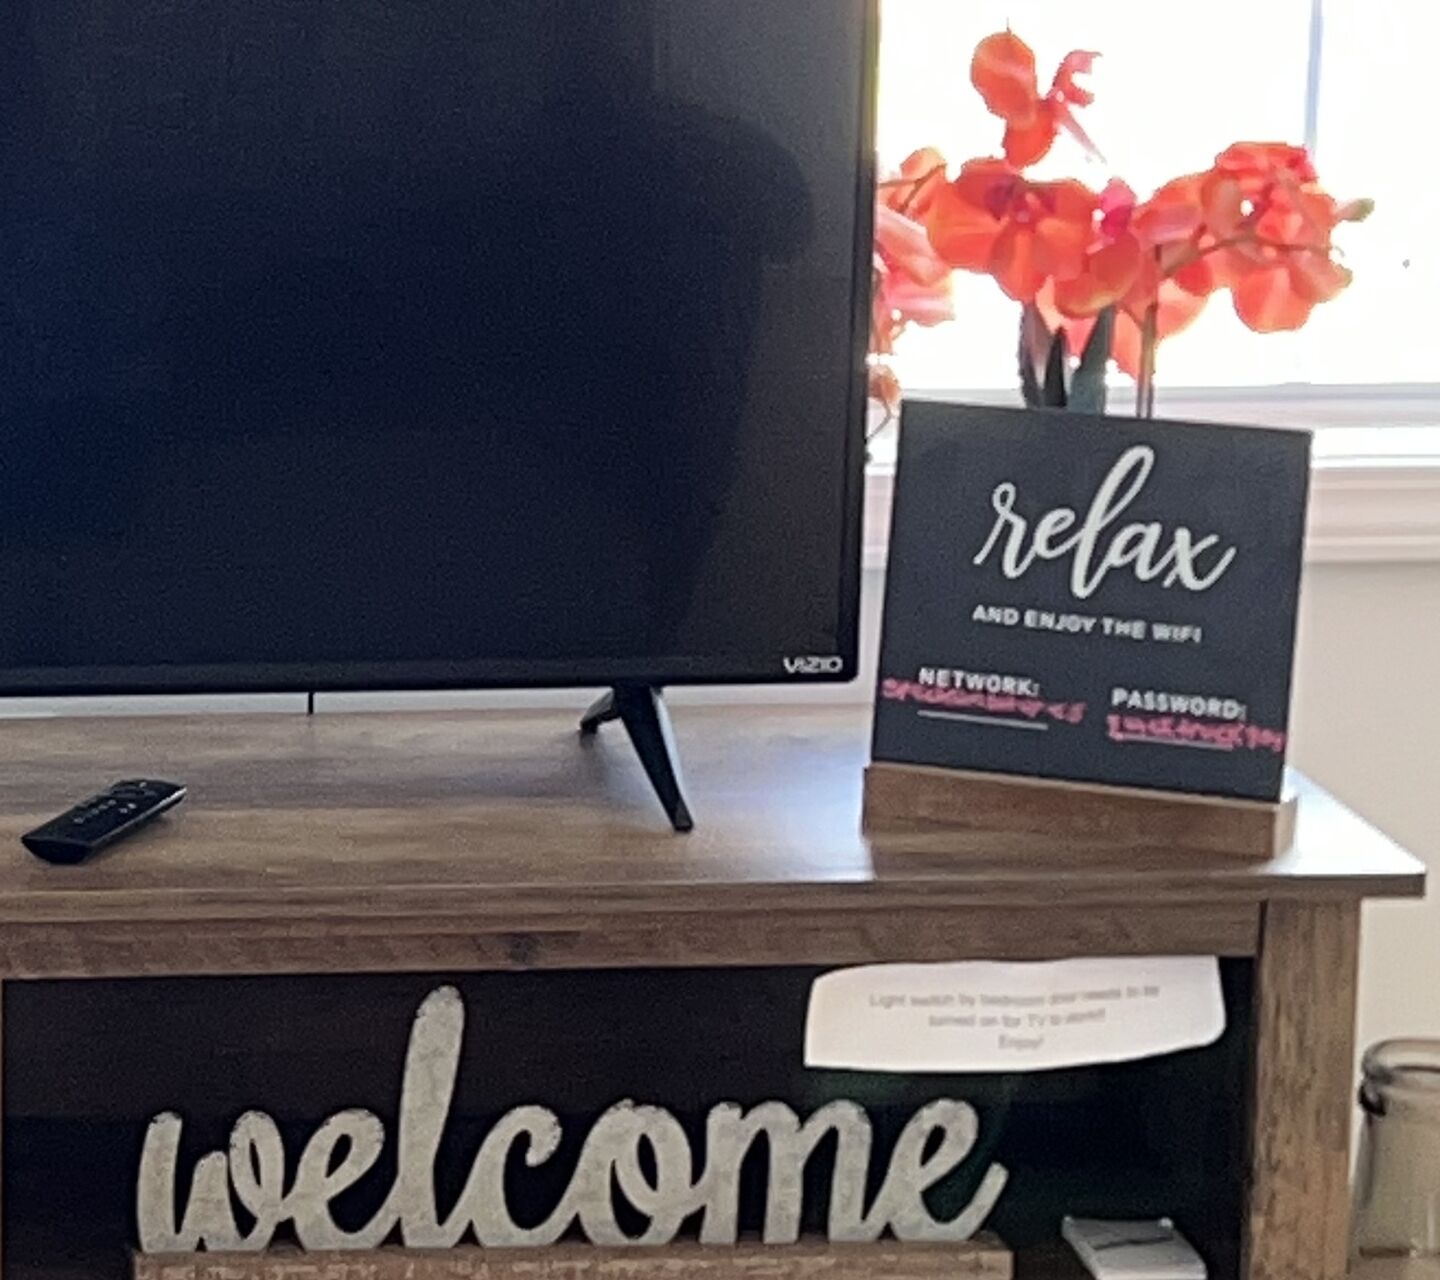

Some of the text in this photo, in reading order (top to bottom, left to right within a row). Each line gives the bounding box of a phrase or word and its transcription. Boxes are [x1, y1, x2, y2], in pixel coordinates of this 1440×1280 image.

[973, 446, 1236, 599] relax
[972, 604, 1202, 643] AND ENJOY THE WIFI
[783, 656, 843, 673] VIZIO
[918, 667, 1040, 698] NETWORK:
[1111, 687, 1247, 721] PASSWORD:
[136, 984, 1010, 1252] welcome
